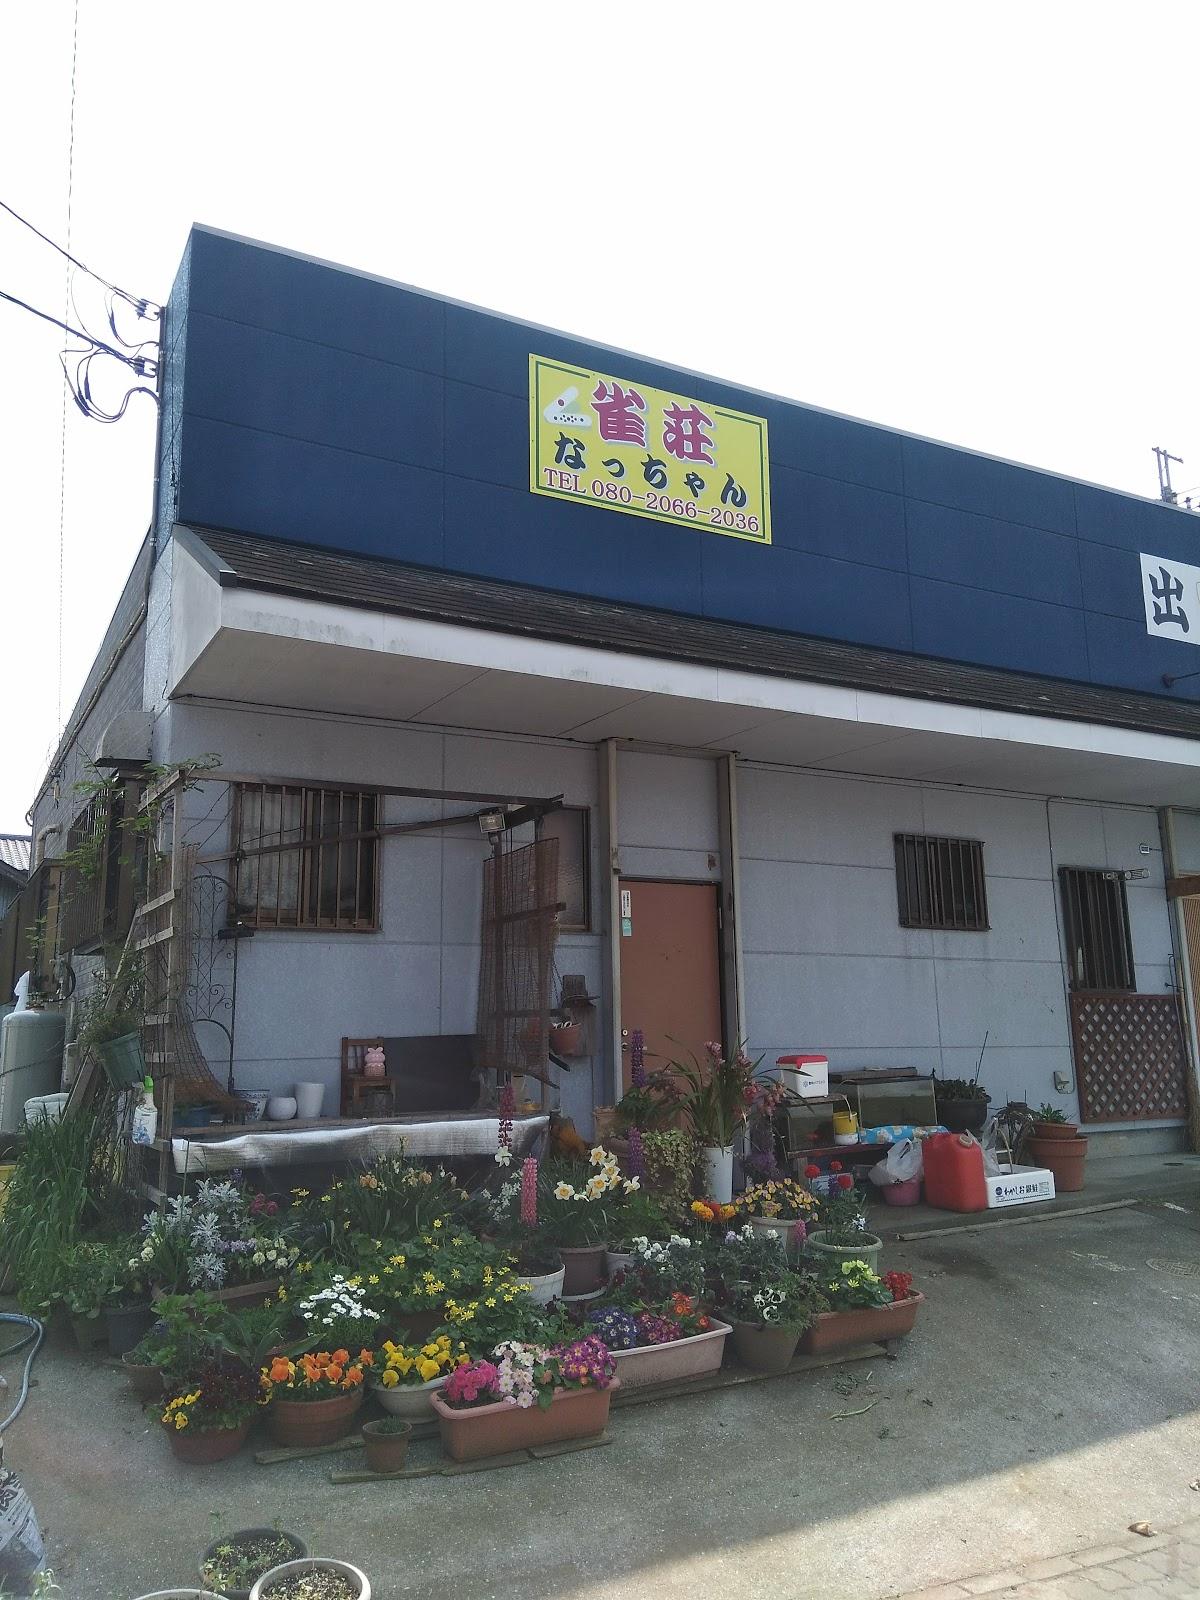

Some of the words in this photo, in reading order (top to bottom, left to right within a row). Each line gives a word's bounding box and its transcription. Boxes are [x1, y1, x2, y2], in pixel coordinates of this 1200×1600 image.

[591, 379, 715, 465] 雀荘
[544, 468, 587, 494] TEL
[591, 480, 760, 532] 080-2066-2036
[554, 431, 747, 508] なっちゃん
[1149, 566, 1190, 633] 出
